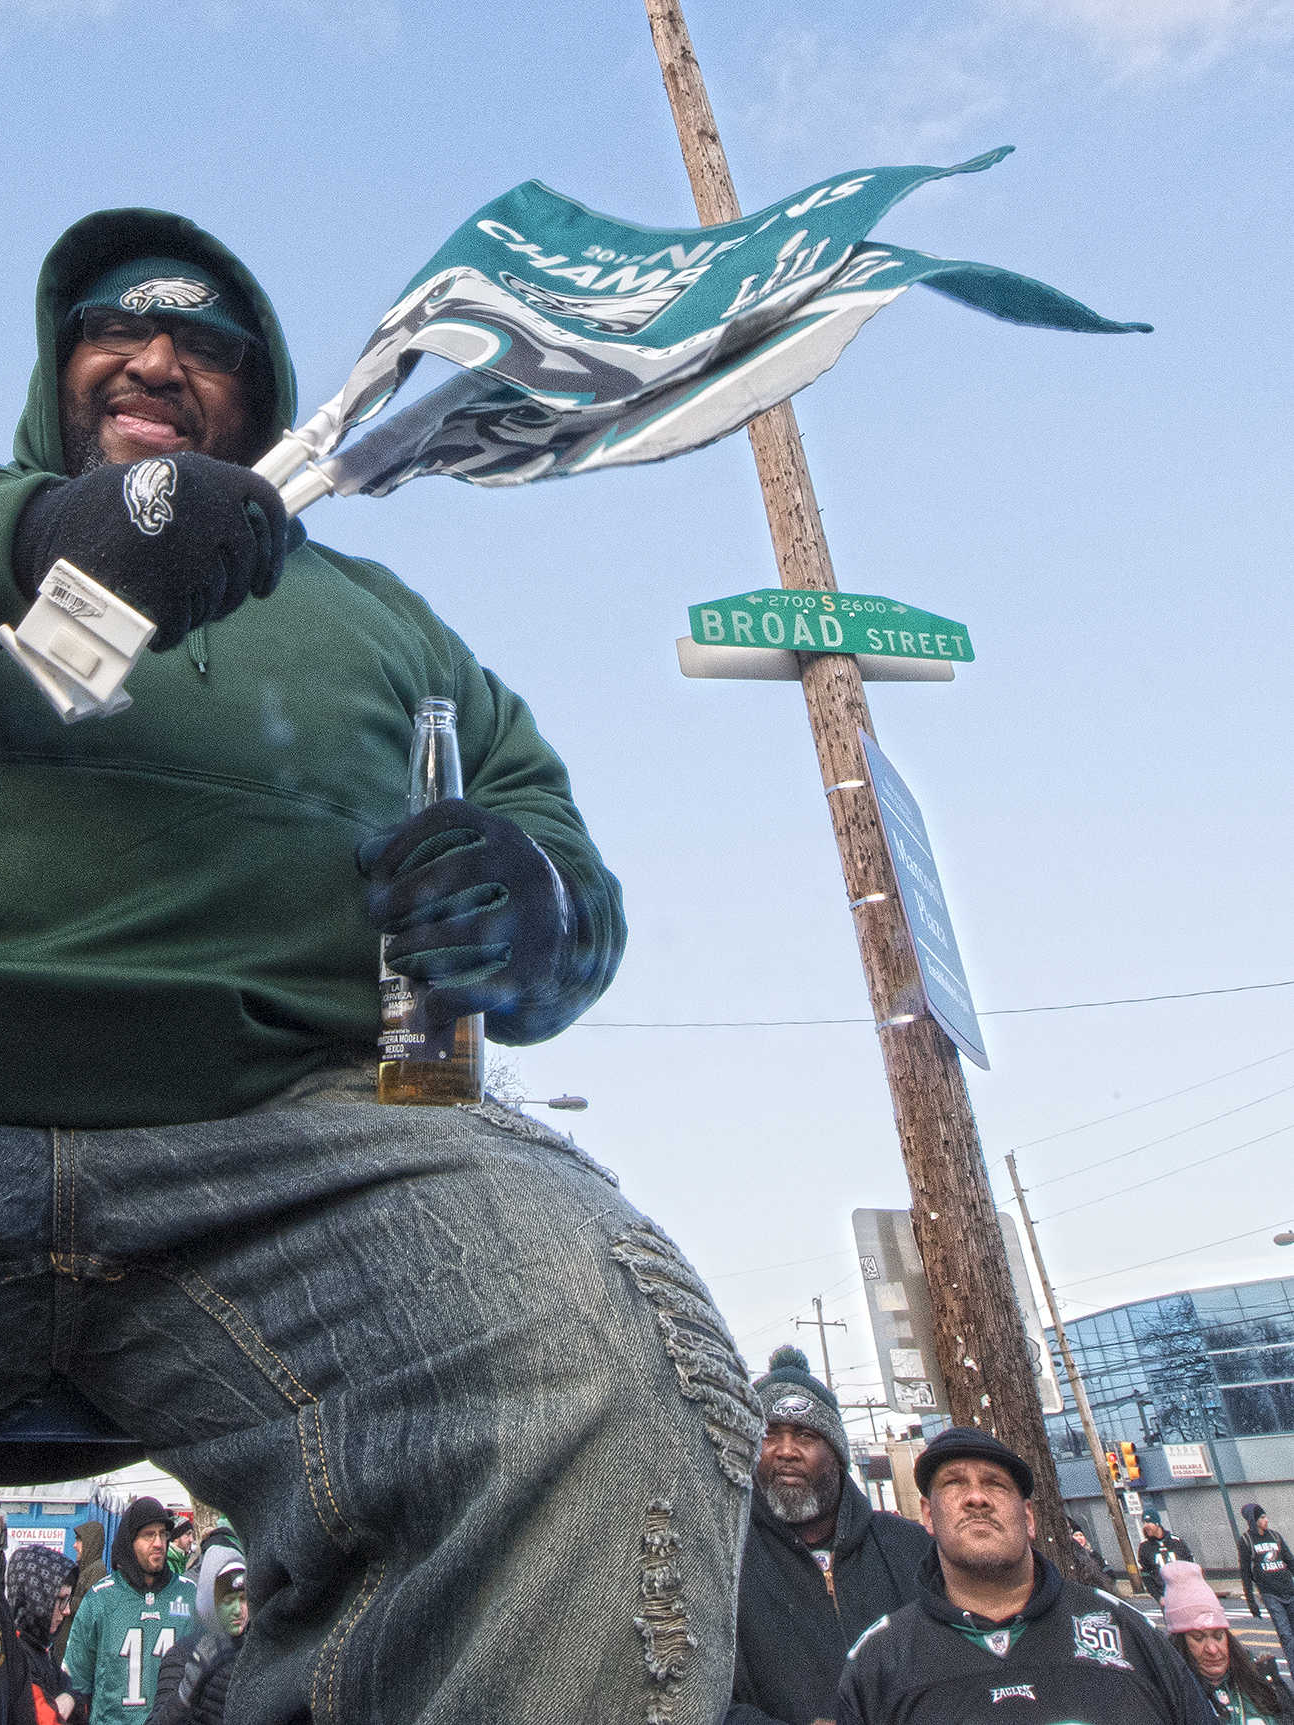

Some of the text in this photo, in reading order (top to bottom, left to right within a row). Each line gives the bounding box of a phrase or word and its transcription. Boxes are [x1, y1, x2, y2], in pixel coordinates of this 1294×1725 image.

[768, 595, 886, 614] 2700 S 2600
[700, 608, 964, 657] BROAD STREET
[400, 1032, 426, 1044] MODELO
[10, 1529, 63, 1539] ROYAL FLUSH
[989, 1684, 1036, 1703] EAGLES
